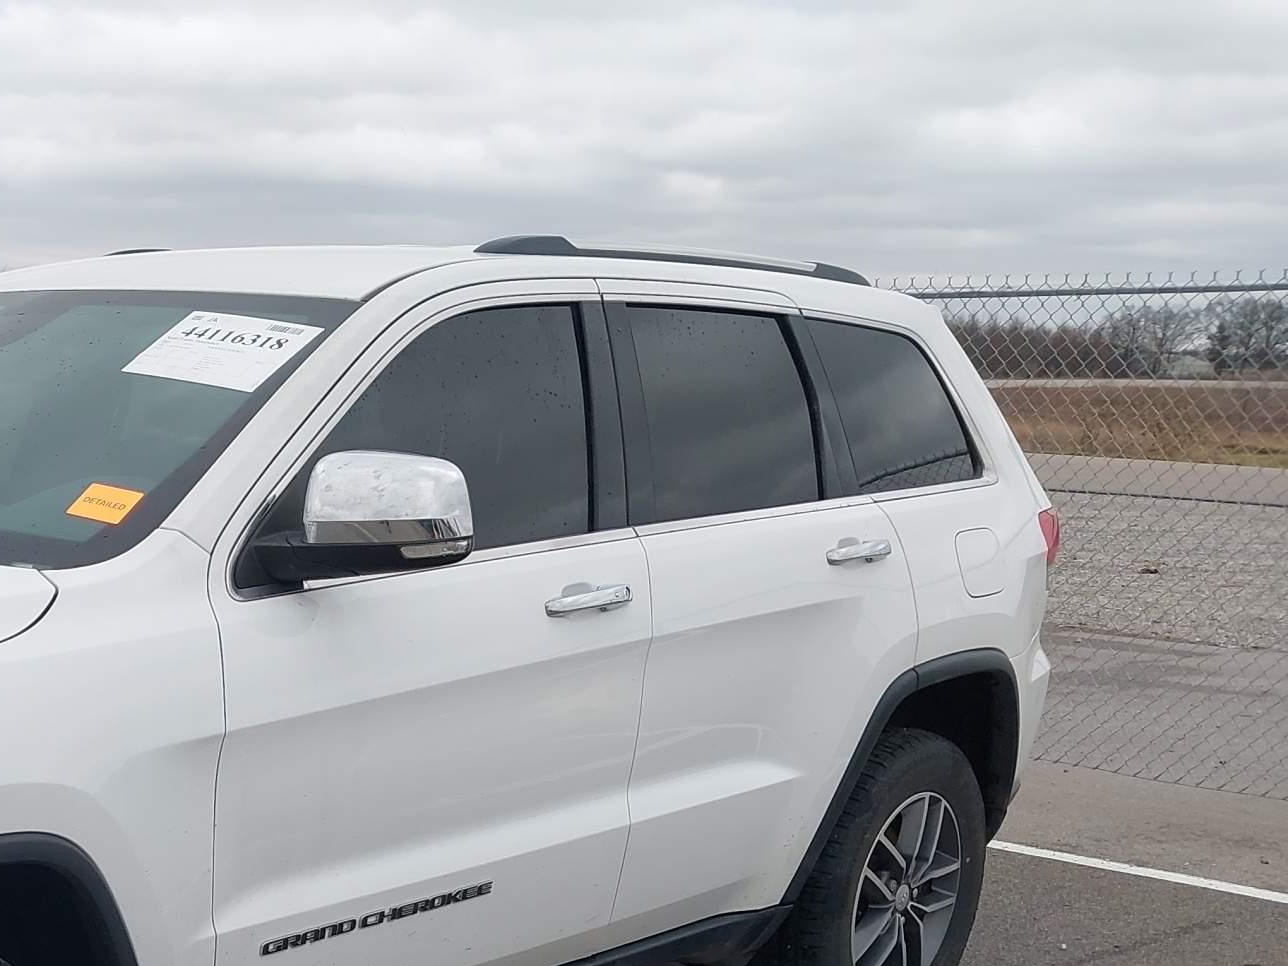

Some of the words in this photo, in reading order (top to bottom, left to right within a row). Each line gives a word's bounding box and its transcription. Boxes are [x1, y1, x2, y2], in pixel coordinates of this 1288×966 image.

[180, 325, 289, 351] 44116318
[82, 495, 127, 511] DETAILED
[260, 917, 357, 957] GRAND
[359, 880, 494, 929] CHEROKEE
